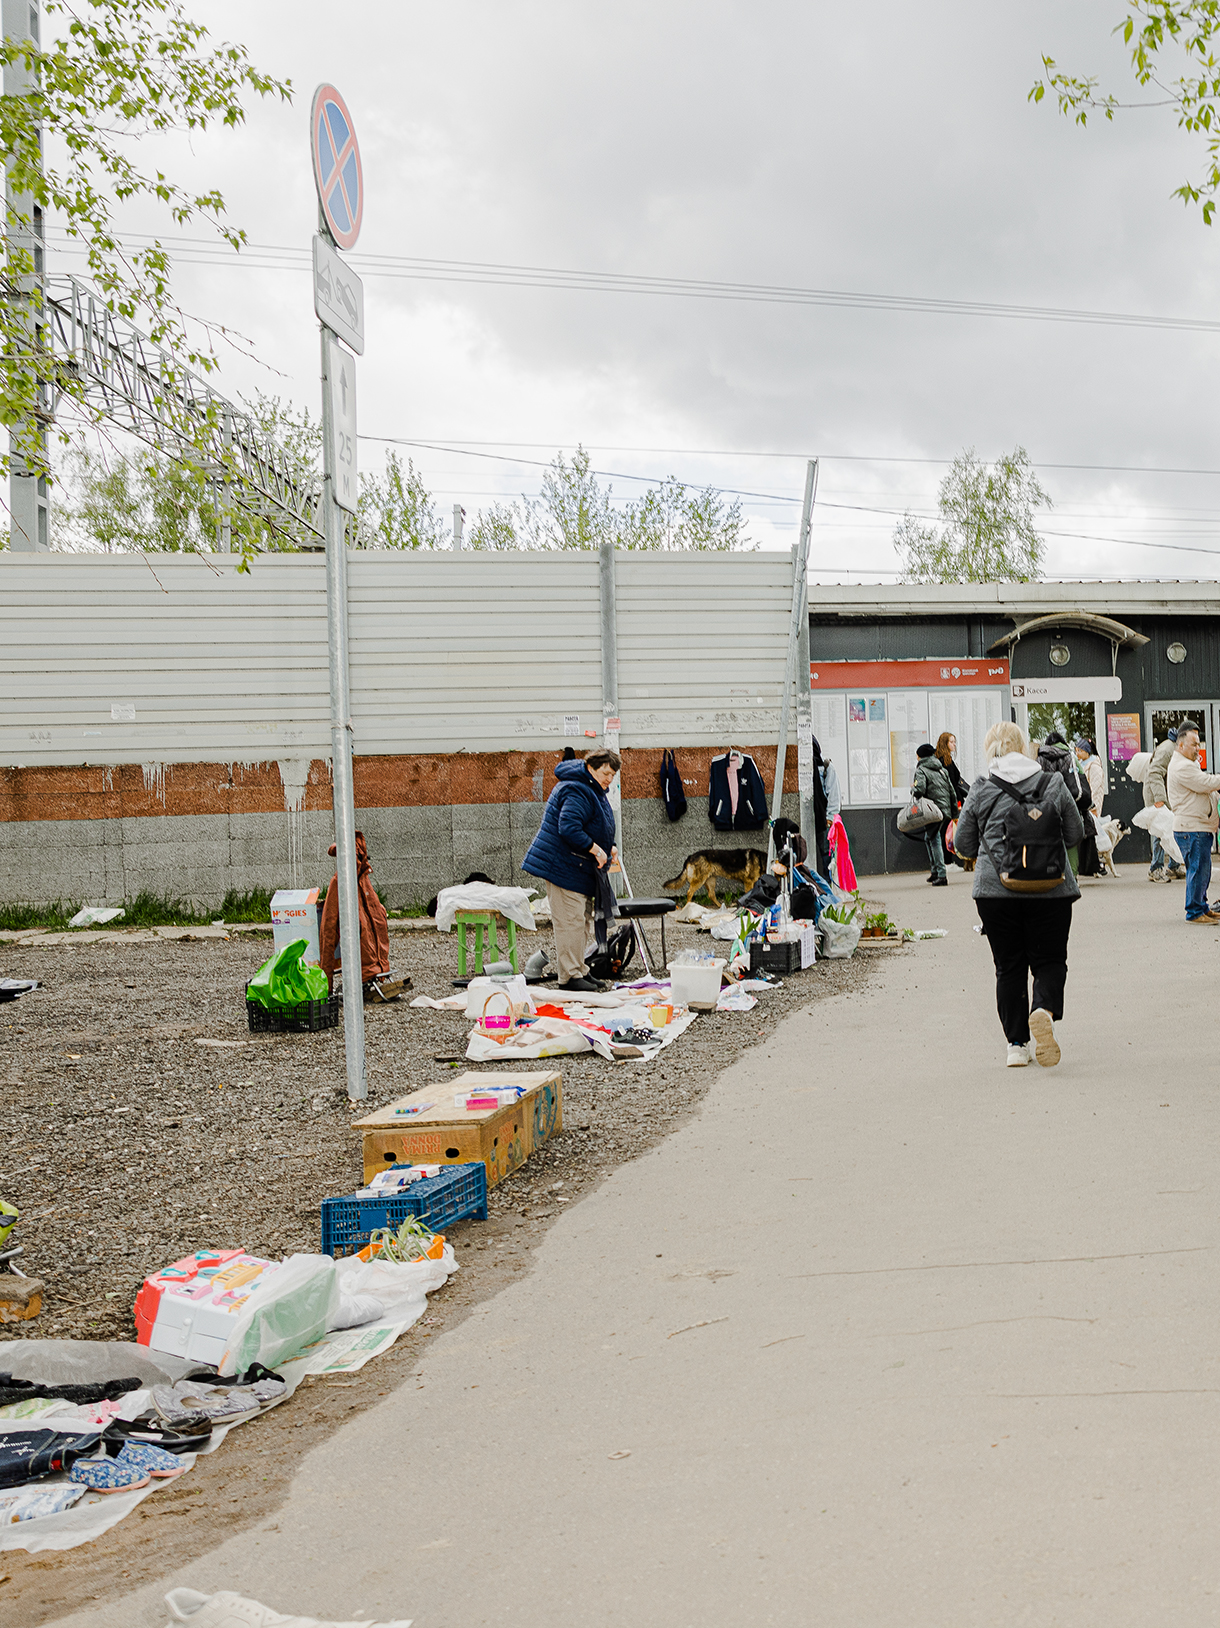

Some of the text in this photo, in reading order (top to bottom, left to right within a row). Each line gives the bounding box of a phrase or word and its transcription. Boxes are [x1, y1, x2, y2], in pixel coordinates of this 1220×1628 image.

[339, 431, 353, 467] 25
[272, 909, 307, 918] HGGIES
[401, 1134, 441, 1146] DONNA
[402, 1144, 441, 1154] PRIMA
